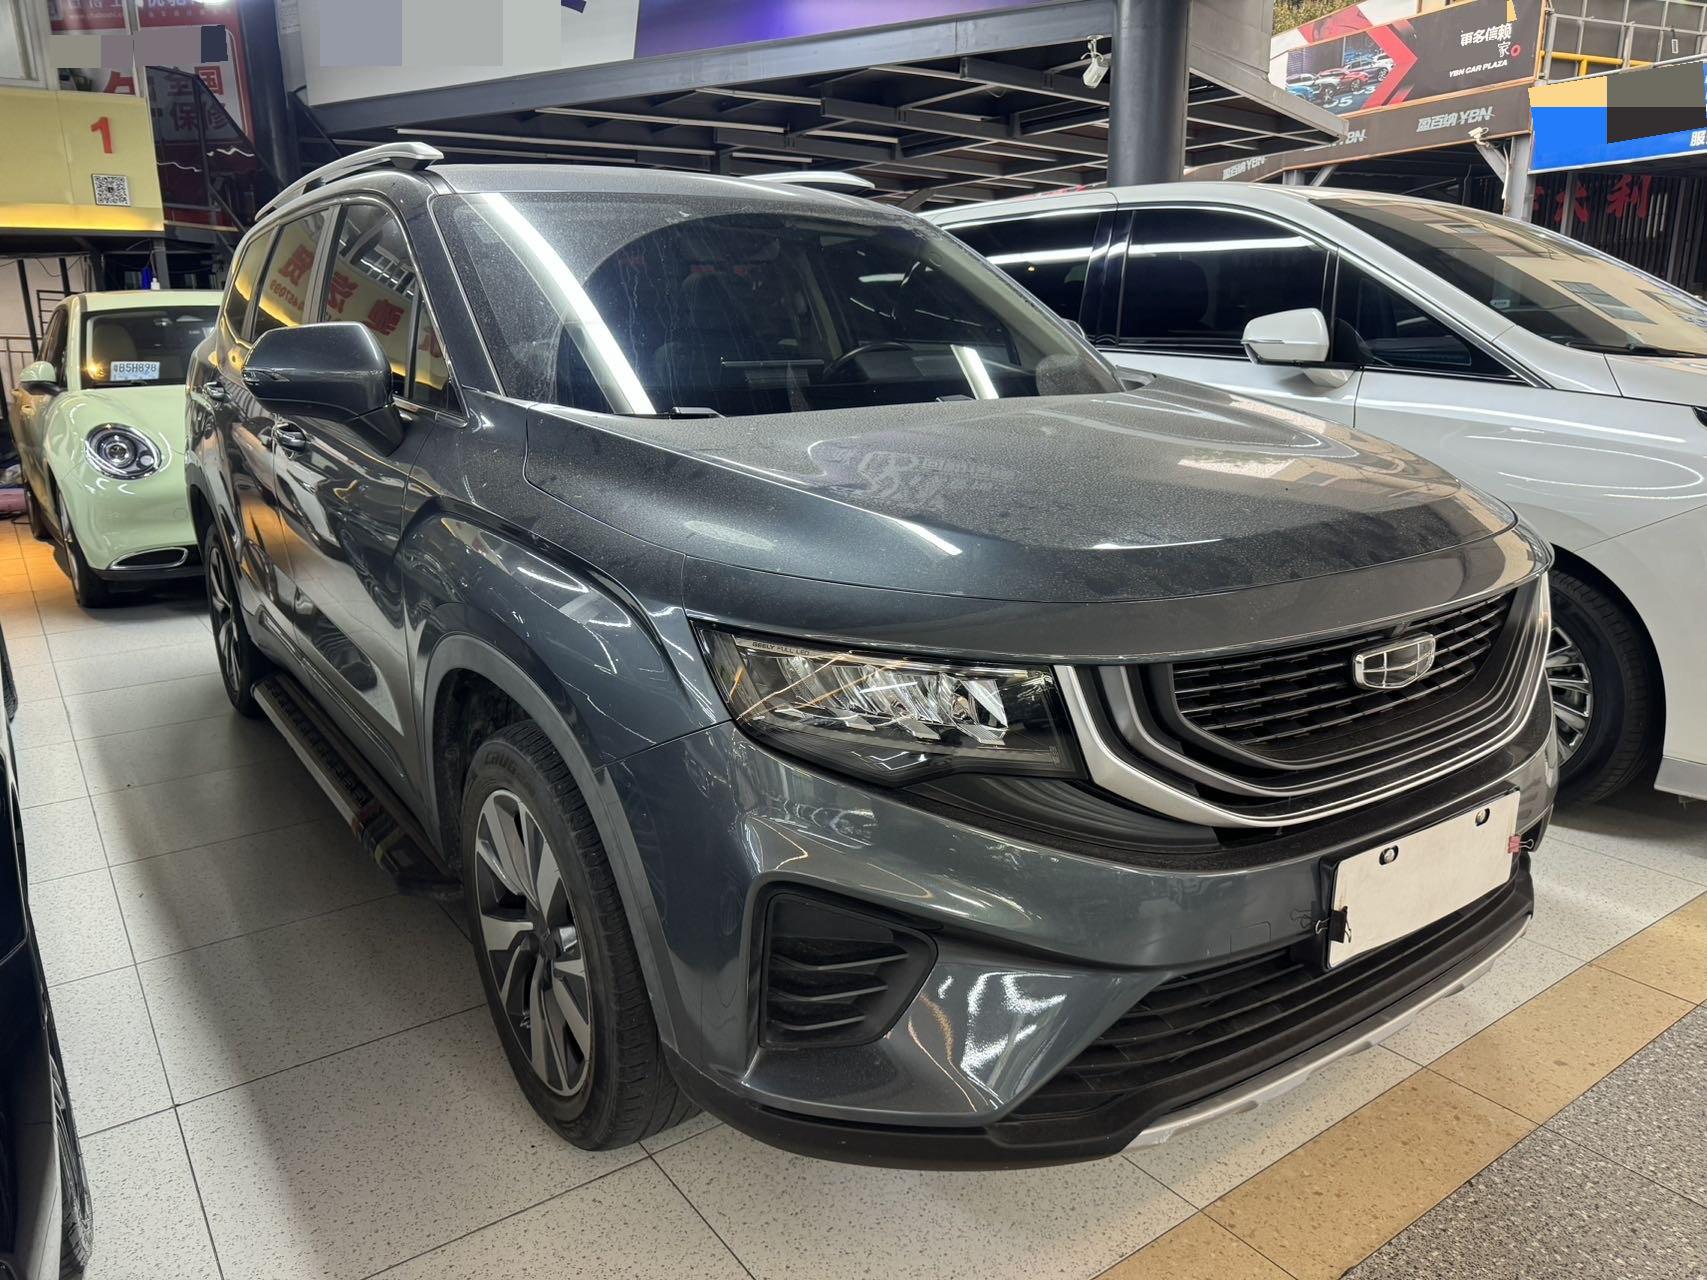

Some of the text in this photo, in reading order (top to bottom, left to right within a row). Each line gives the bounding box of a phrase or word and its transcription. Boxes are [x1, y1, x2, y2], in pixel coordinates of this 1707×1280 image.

[1449, 60, 1508, 77] YBN CAR PLAZA
[1458, 106, 1496, 125] YBN
[90, 116, 113, 154] 1
